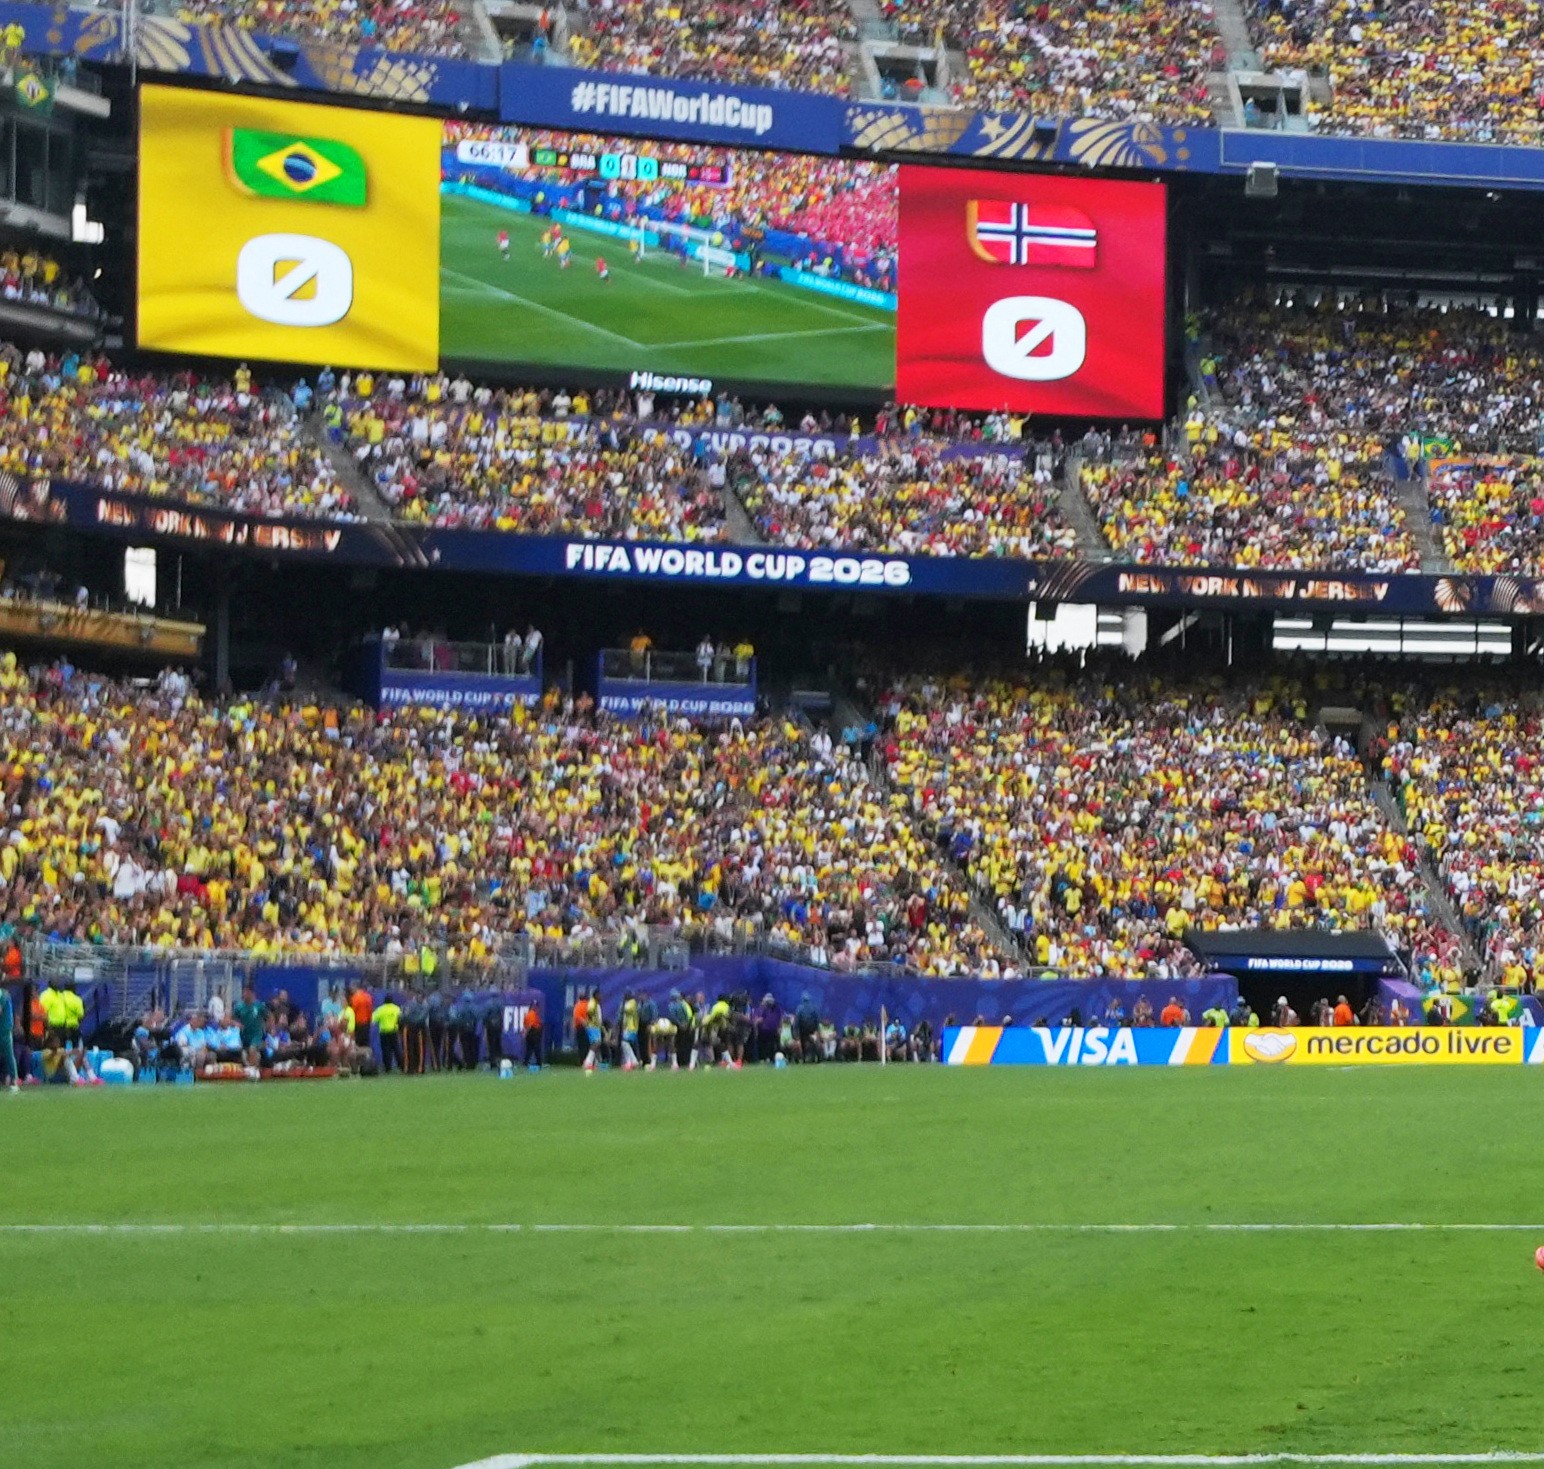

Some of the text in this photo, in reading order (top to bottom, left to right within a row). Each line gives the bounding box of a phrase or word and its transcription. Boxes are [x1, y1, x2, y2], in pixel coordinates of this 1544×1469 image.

[571, 81, 773, 135] #FIFAWorldCup
[630, 371, 712, 395] Hisense
[566, 543, 912, 585] FIFA WORLD CUP 2026
[1030, 1027, 1140, 1065] VISA
[1306, 1029, 1513, 1057] mercado livre
